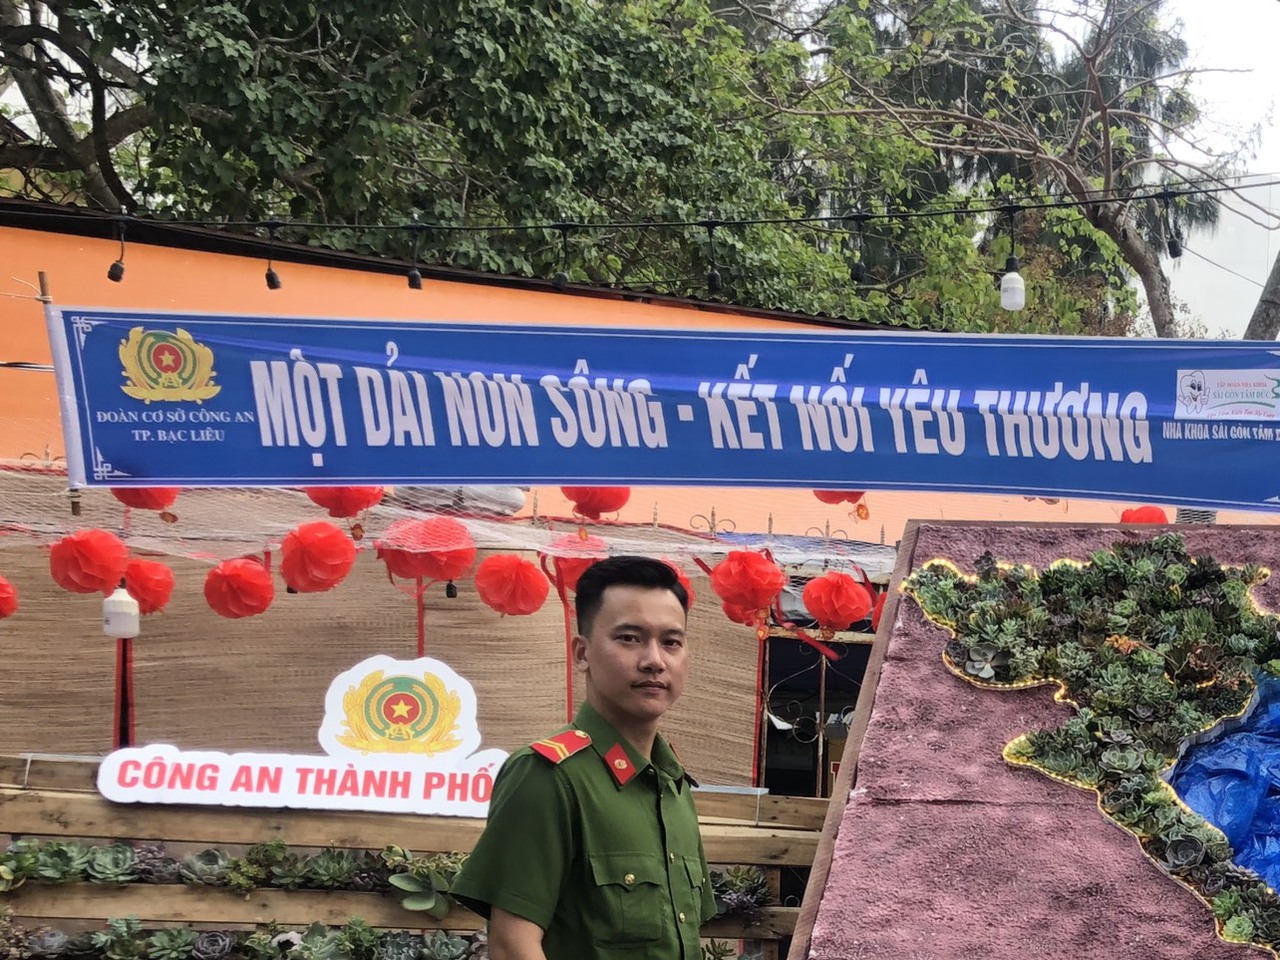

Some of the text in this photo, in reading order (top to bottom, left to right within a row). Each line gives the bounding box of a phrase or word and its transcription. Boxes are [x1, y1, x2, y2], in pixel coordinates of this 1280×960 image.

[250, 348, 347, 467] MỘT
[352, 341, 436, 447] DẢI
[433, 371, 540, 447] NON
[539, 359, 669, 449] SÔNG
[698, 354, 783, 450] KẾT
[789, 353, 875, 453] NỐI
[879, 368, 966, 456] YÊU
[973, 381, 1153, 464] THƯƠNG
[96, 407, 139, 423] ĐOÀN
[142, 409, 164, 423] CƠ
[189, 407, 231, 423] CÔNG
[234, 411, 255, 423] AN
[131, 427, 225, 444] TP. BẠC LIÊU
[1163, 421, 1182, 440] NHA
[1184, 422, 1210, 440] KHOA
[1253, 423, 1274, 441] TÂM
[116, 756, 495, 803] CÔNG AN THÀNH PHỐ
